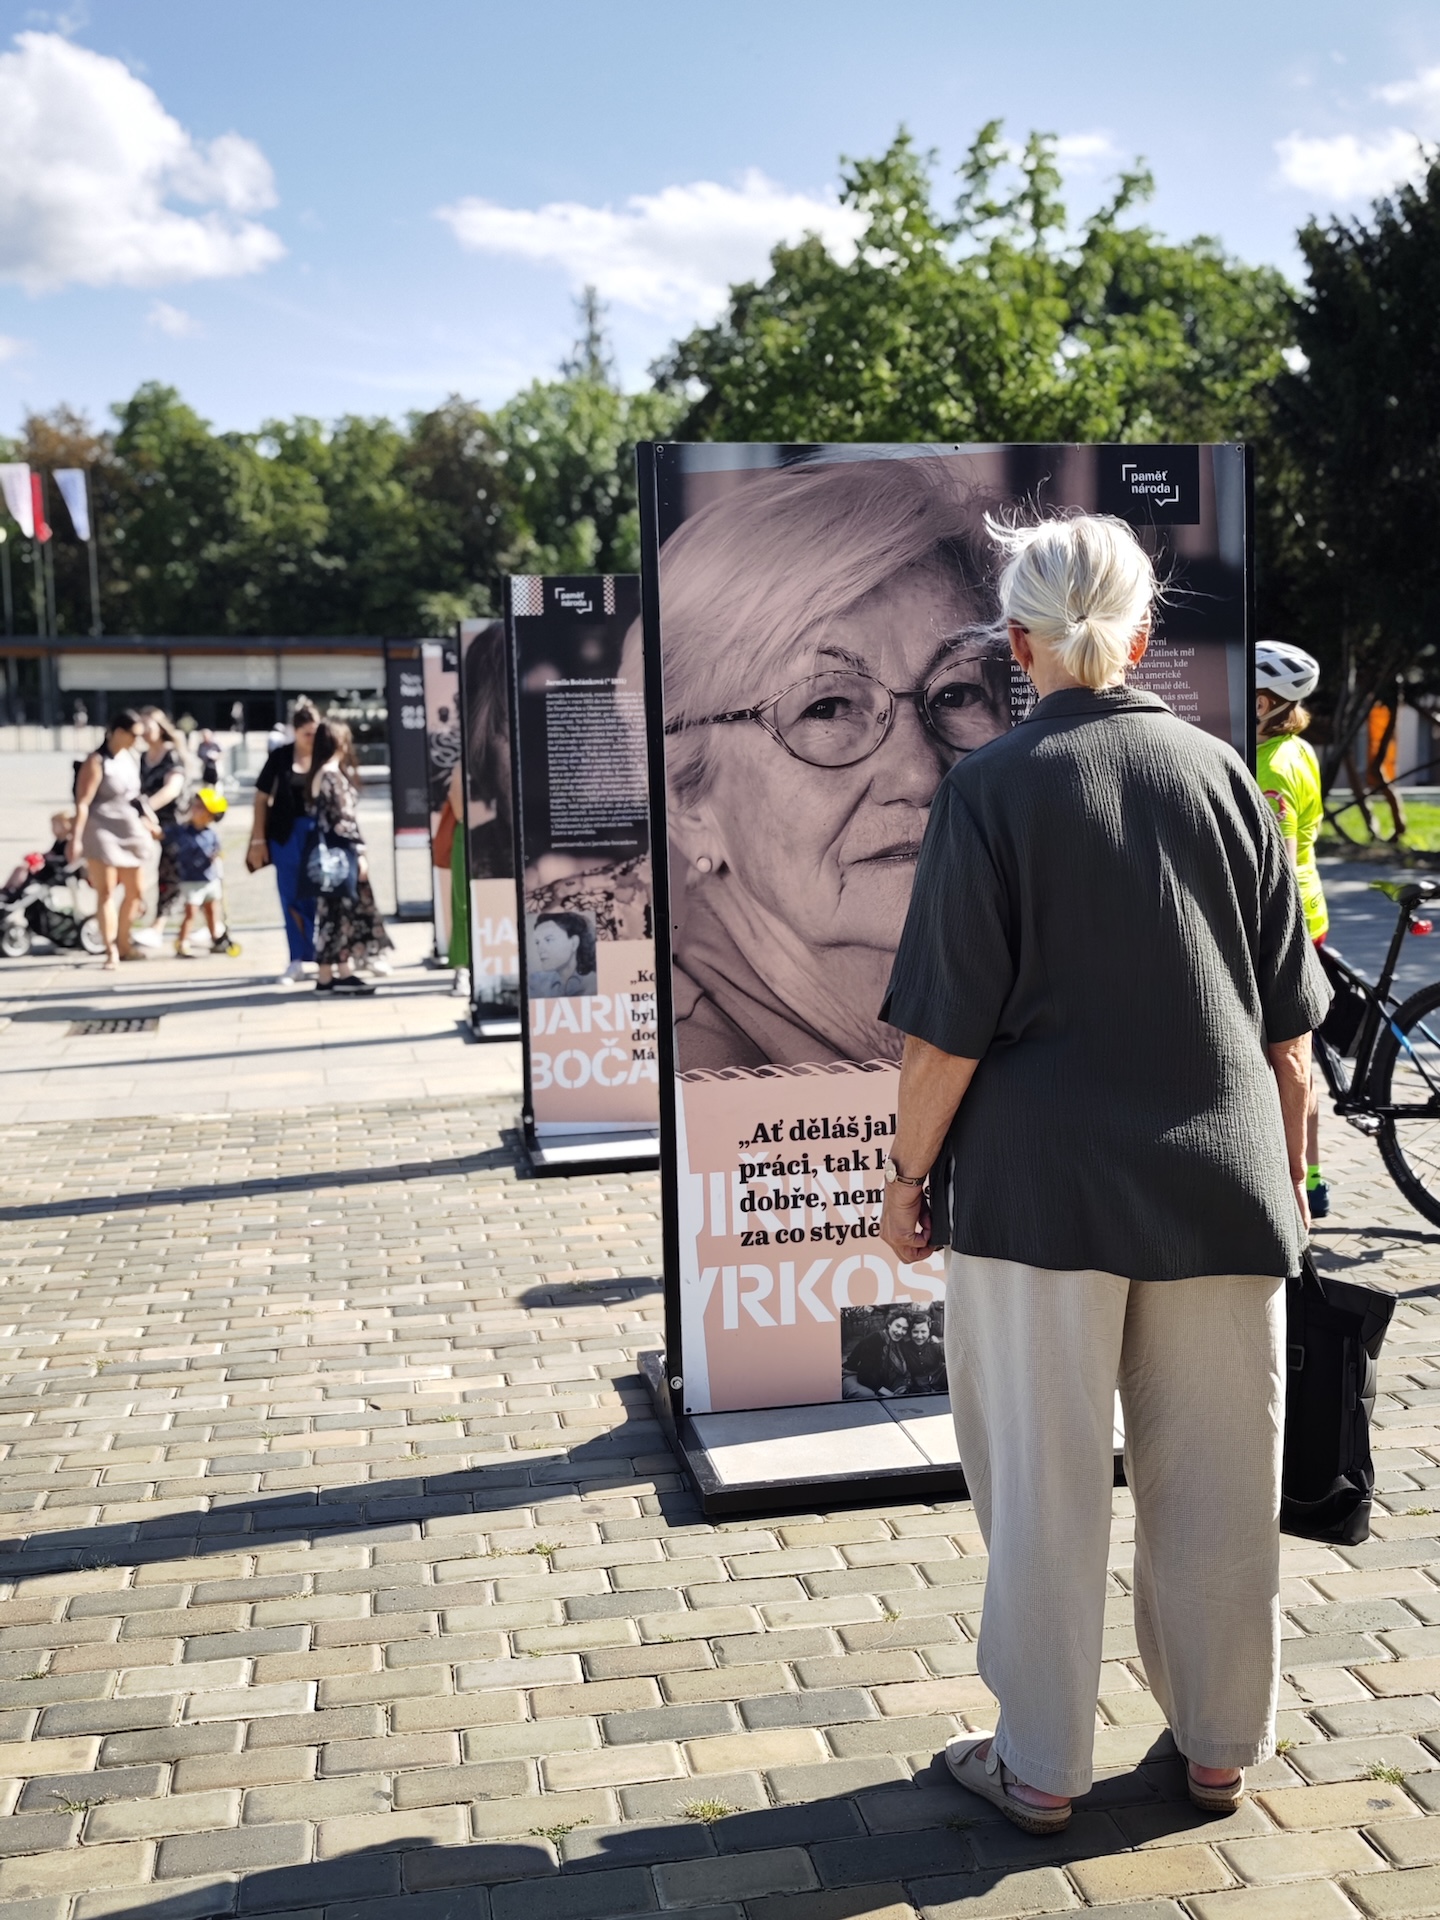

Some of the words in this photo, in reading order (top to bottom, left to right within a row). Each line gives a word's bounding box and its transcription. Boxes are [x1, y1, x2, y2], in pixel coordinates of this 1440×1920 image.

[1131, 470, 1168, 483] paměť
[1131, 483, 1171, 494] národa
[1149, 648, 1179, 657] Tatínek
[1180, 647, 1195, 656] měl
[1138, 659, 1173, 669] kavárnu,
[1174, 659, 1188, 668] kde
[1145, 670, 1182, 679] americké
[1153, 681, 1172, 690] malé
[1173, 681, 1191, 689] děti.
[1162, 692, 1176, 700] nás
[1177, 692, 1199, 700] svezli
[1172, 703, 1177, 711] k
[1178, 703, 1198, 711] moci
[738, 1119, 785, 1149] „Ať
[789, 1116, 859, 1142] děláš
[738, 1153, 818, 1184] práci,
[823, 1149, 870, 1173] tak
[740, 1186, 827, 1213] dobře,
[740, 1226, 769, 1247] za
[775, 1225, 805, 1244] co
